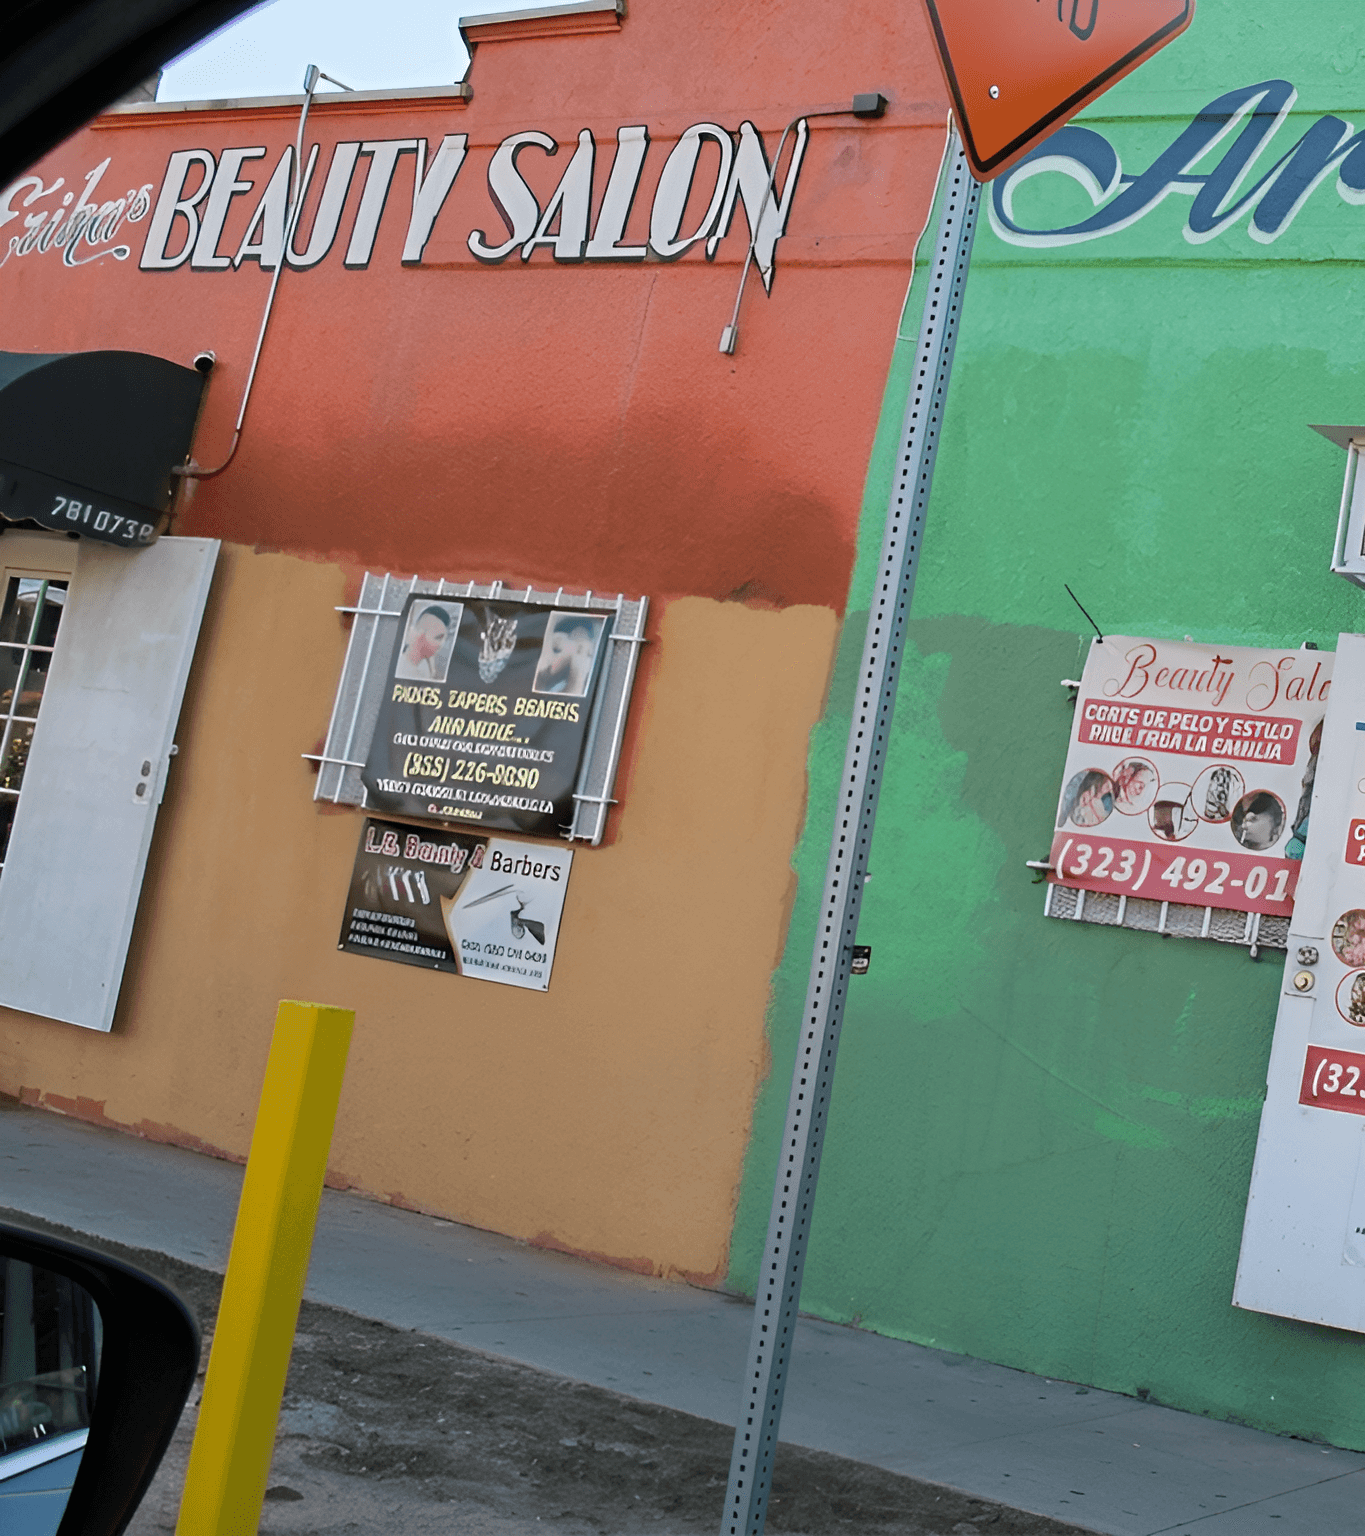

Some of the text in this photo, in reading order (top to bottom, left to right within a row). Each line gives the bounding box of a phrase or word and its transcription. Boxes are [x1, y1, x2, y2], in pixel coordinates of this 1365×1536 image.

[139, 133, 468, 270] BEAUTY
[467, 118, 810, 297] SALON
[1216, 717, 1229, 733] Y
[490, 850, 561, 881] Barbers
[1056, 839, 1151, 890] (323)
